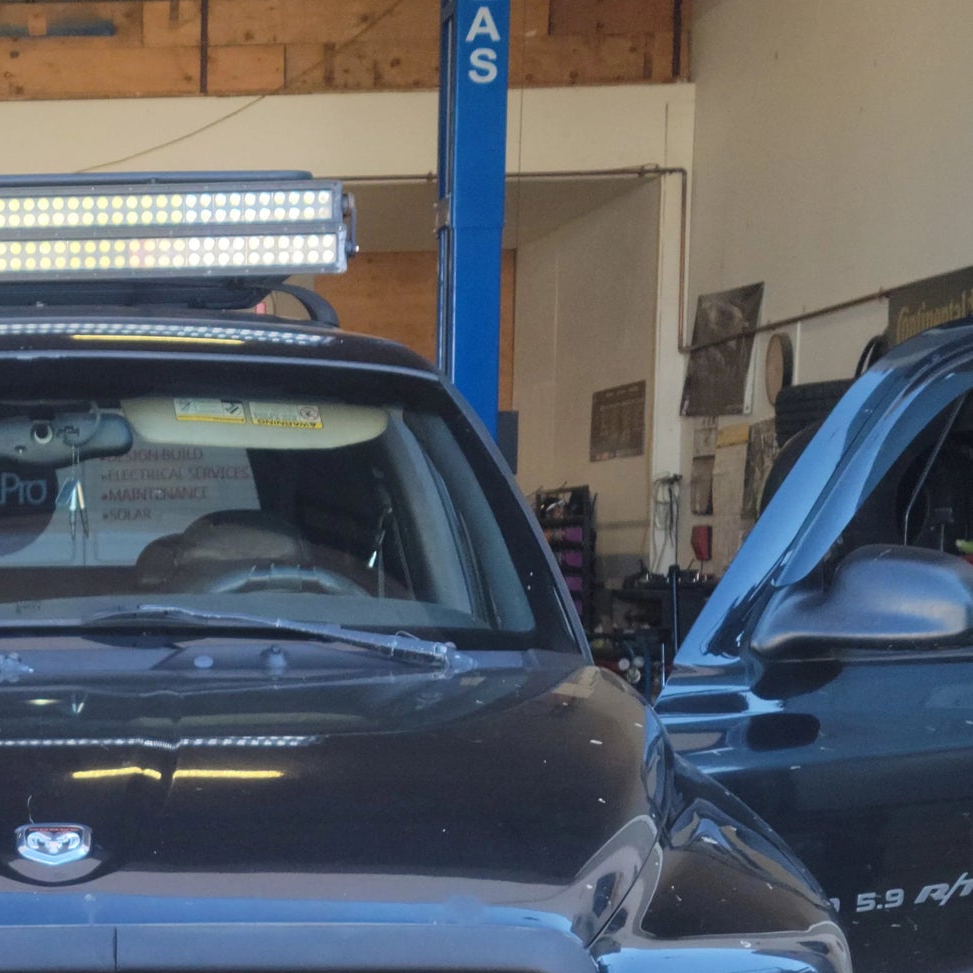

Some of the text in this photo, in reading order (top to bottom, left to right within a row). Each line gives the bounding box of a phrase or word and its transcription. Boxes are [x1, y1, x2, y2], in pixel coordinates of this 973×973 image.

[108, 465, 250, 481] ELECTRICAL SERVICES
[109, 486, 208, 501] MAINTENANCE
[110, 507, 152, 520] SOLAR
[856, 888, 905, 913] 5.9
